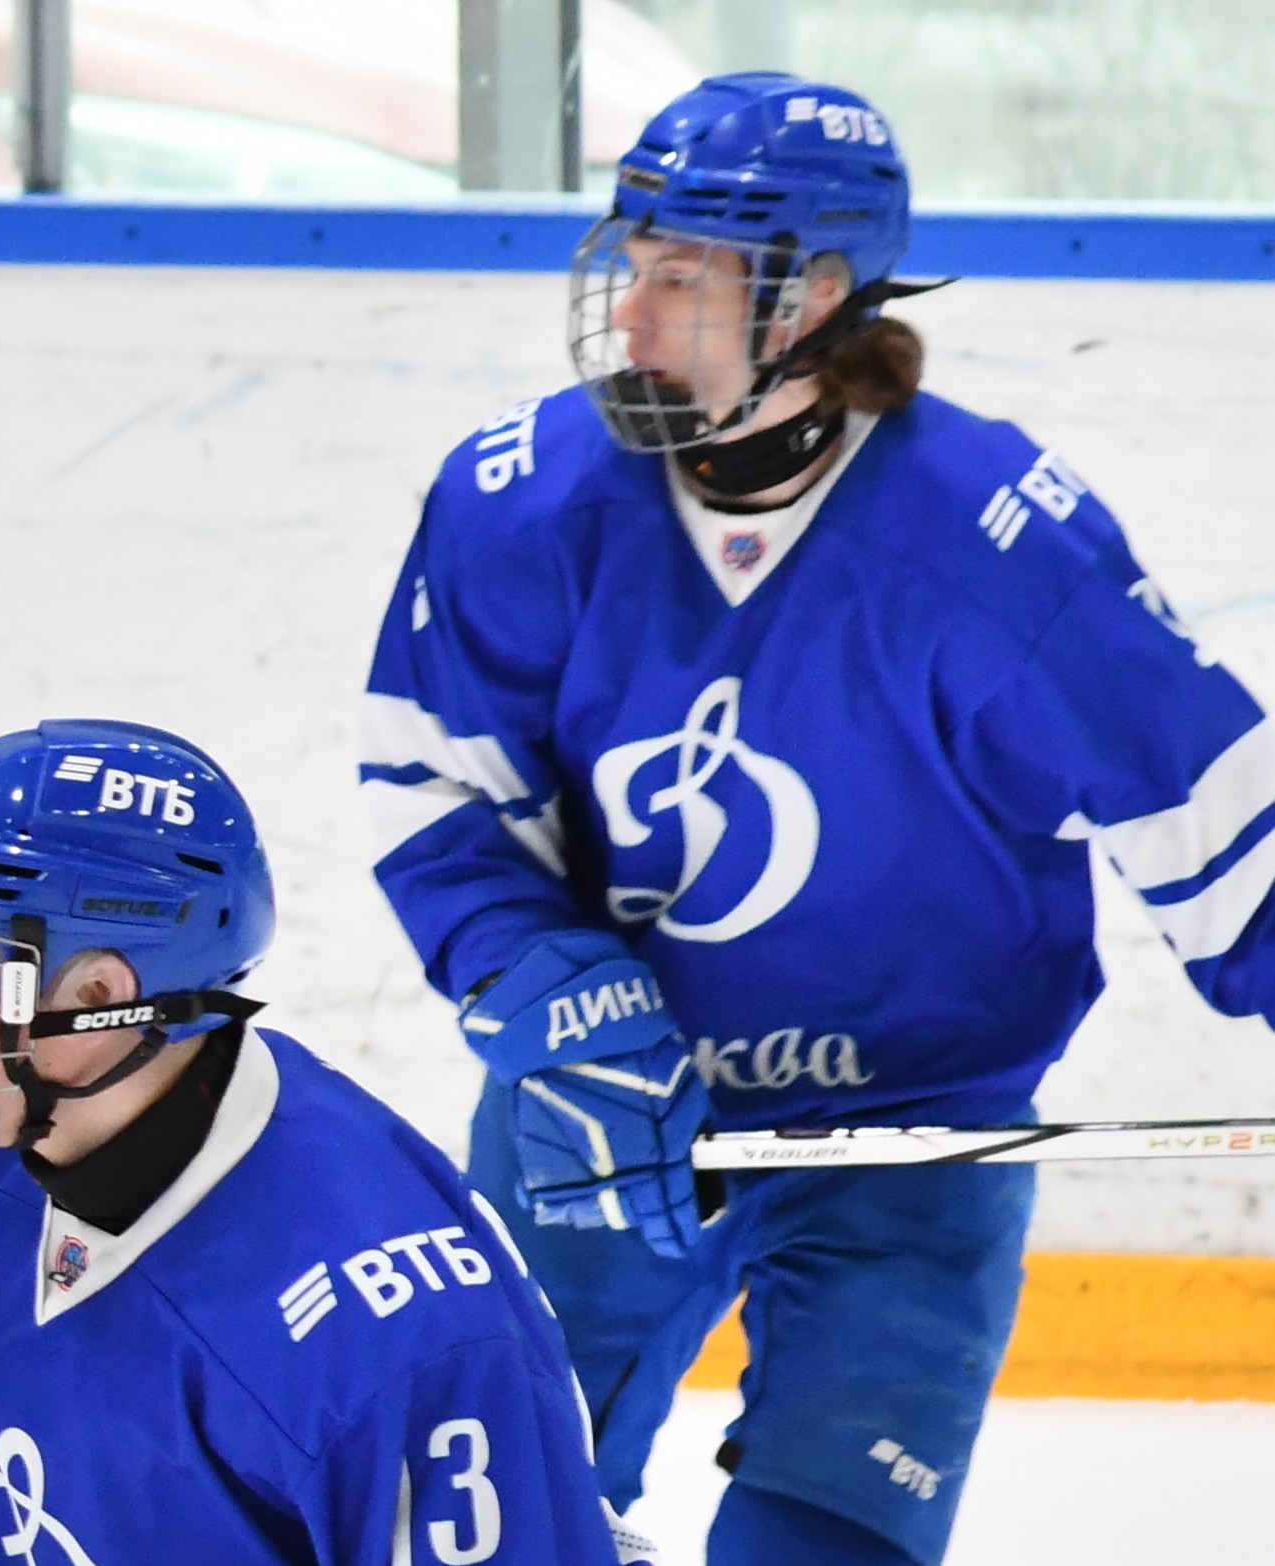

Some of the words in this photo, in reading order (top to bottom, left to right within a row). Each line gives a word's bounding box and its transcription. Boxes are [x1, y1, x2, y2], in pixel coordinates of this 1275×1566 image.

[1017, 450, 1091, 523] ВТ
[100, 769, 195, 827] ВТБ
[73, 1005, 155, 1031] SOYUZ
[692, 1026, 876, 1088] ква
[343, 1226, 492, 1319] ВТБ
